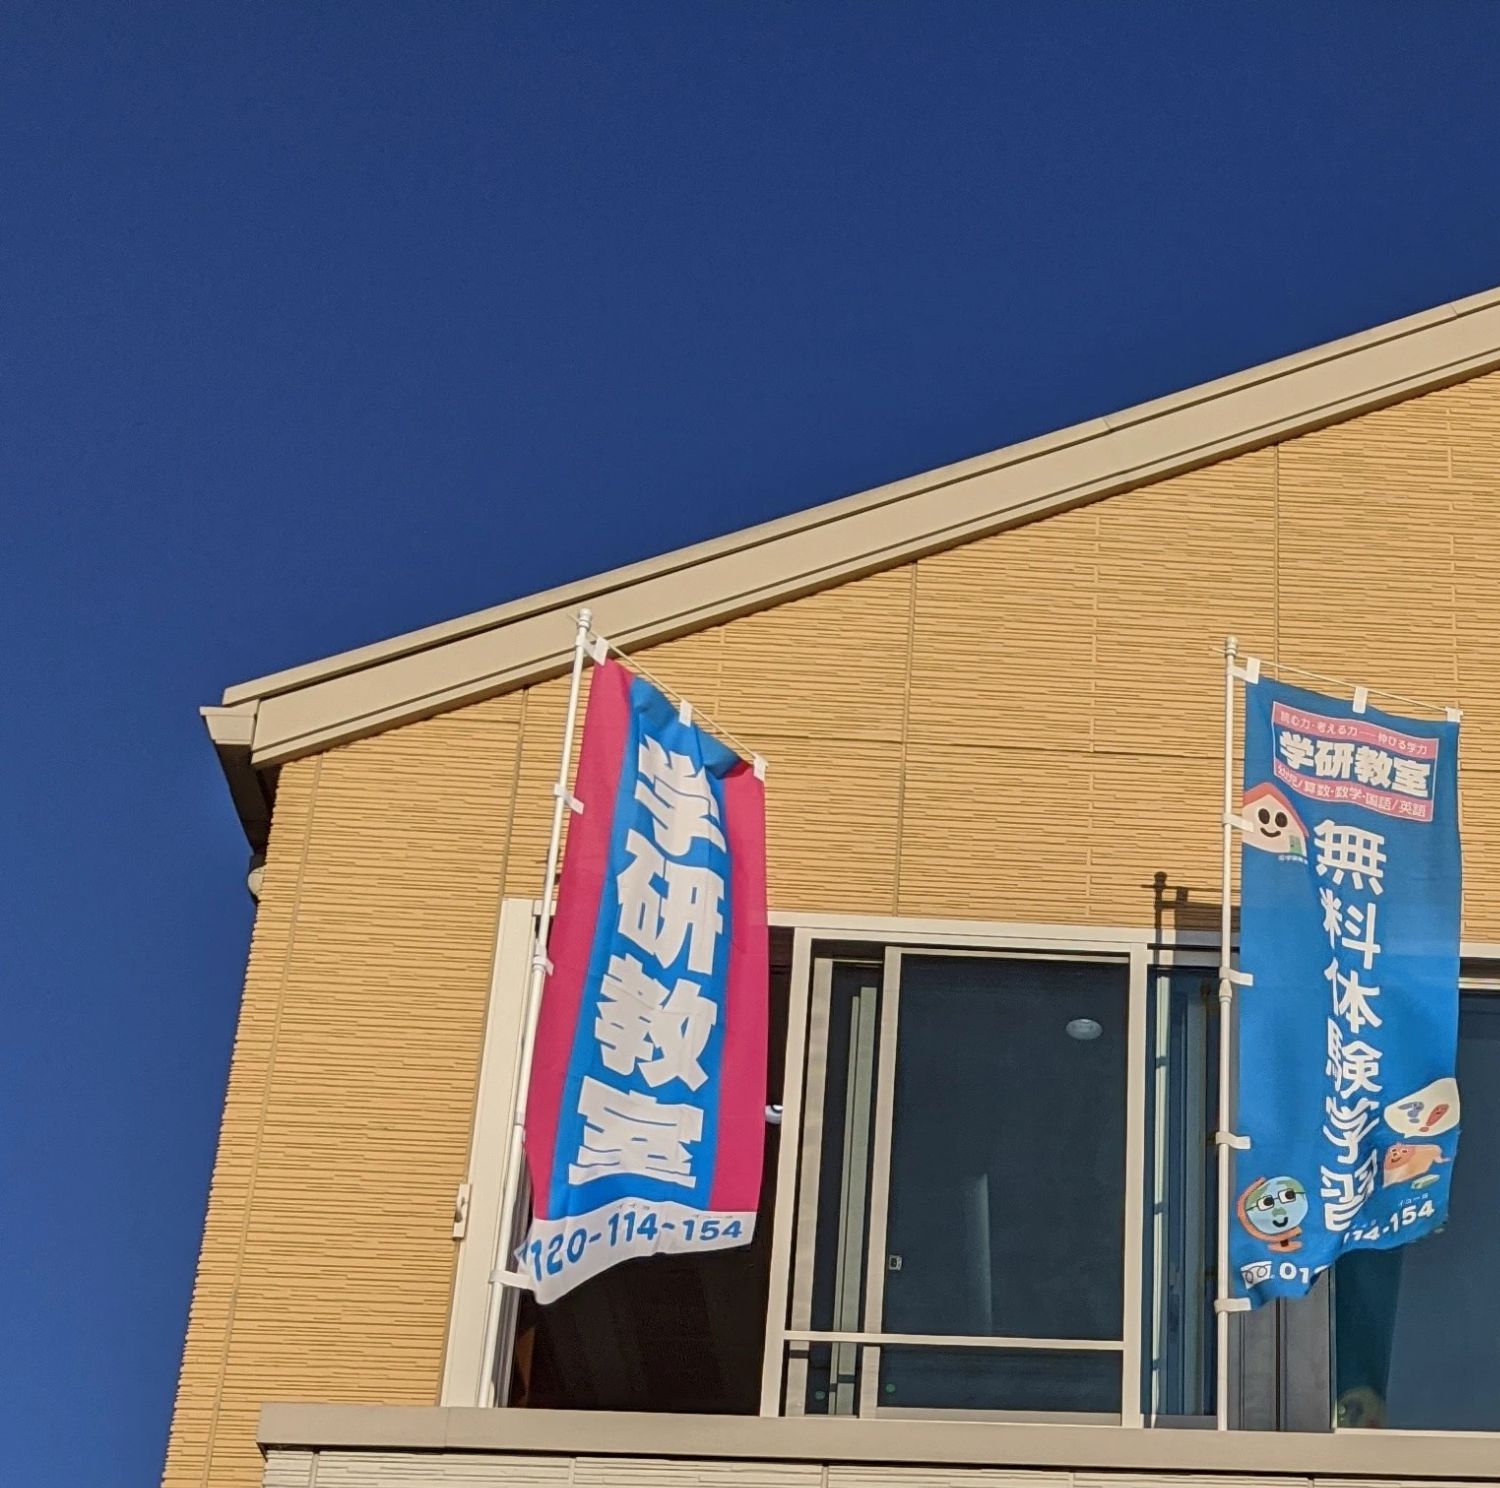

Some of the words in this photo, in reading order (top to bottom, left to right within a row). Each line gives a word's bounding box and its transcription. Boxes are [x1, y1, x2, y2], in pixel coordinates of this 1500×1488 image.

[1279, 731, 1431, 798] 学研教室
[568, 735, 727, 1188] 学研教室
